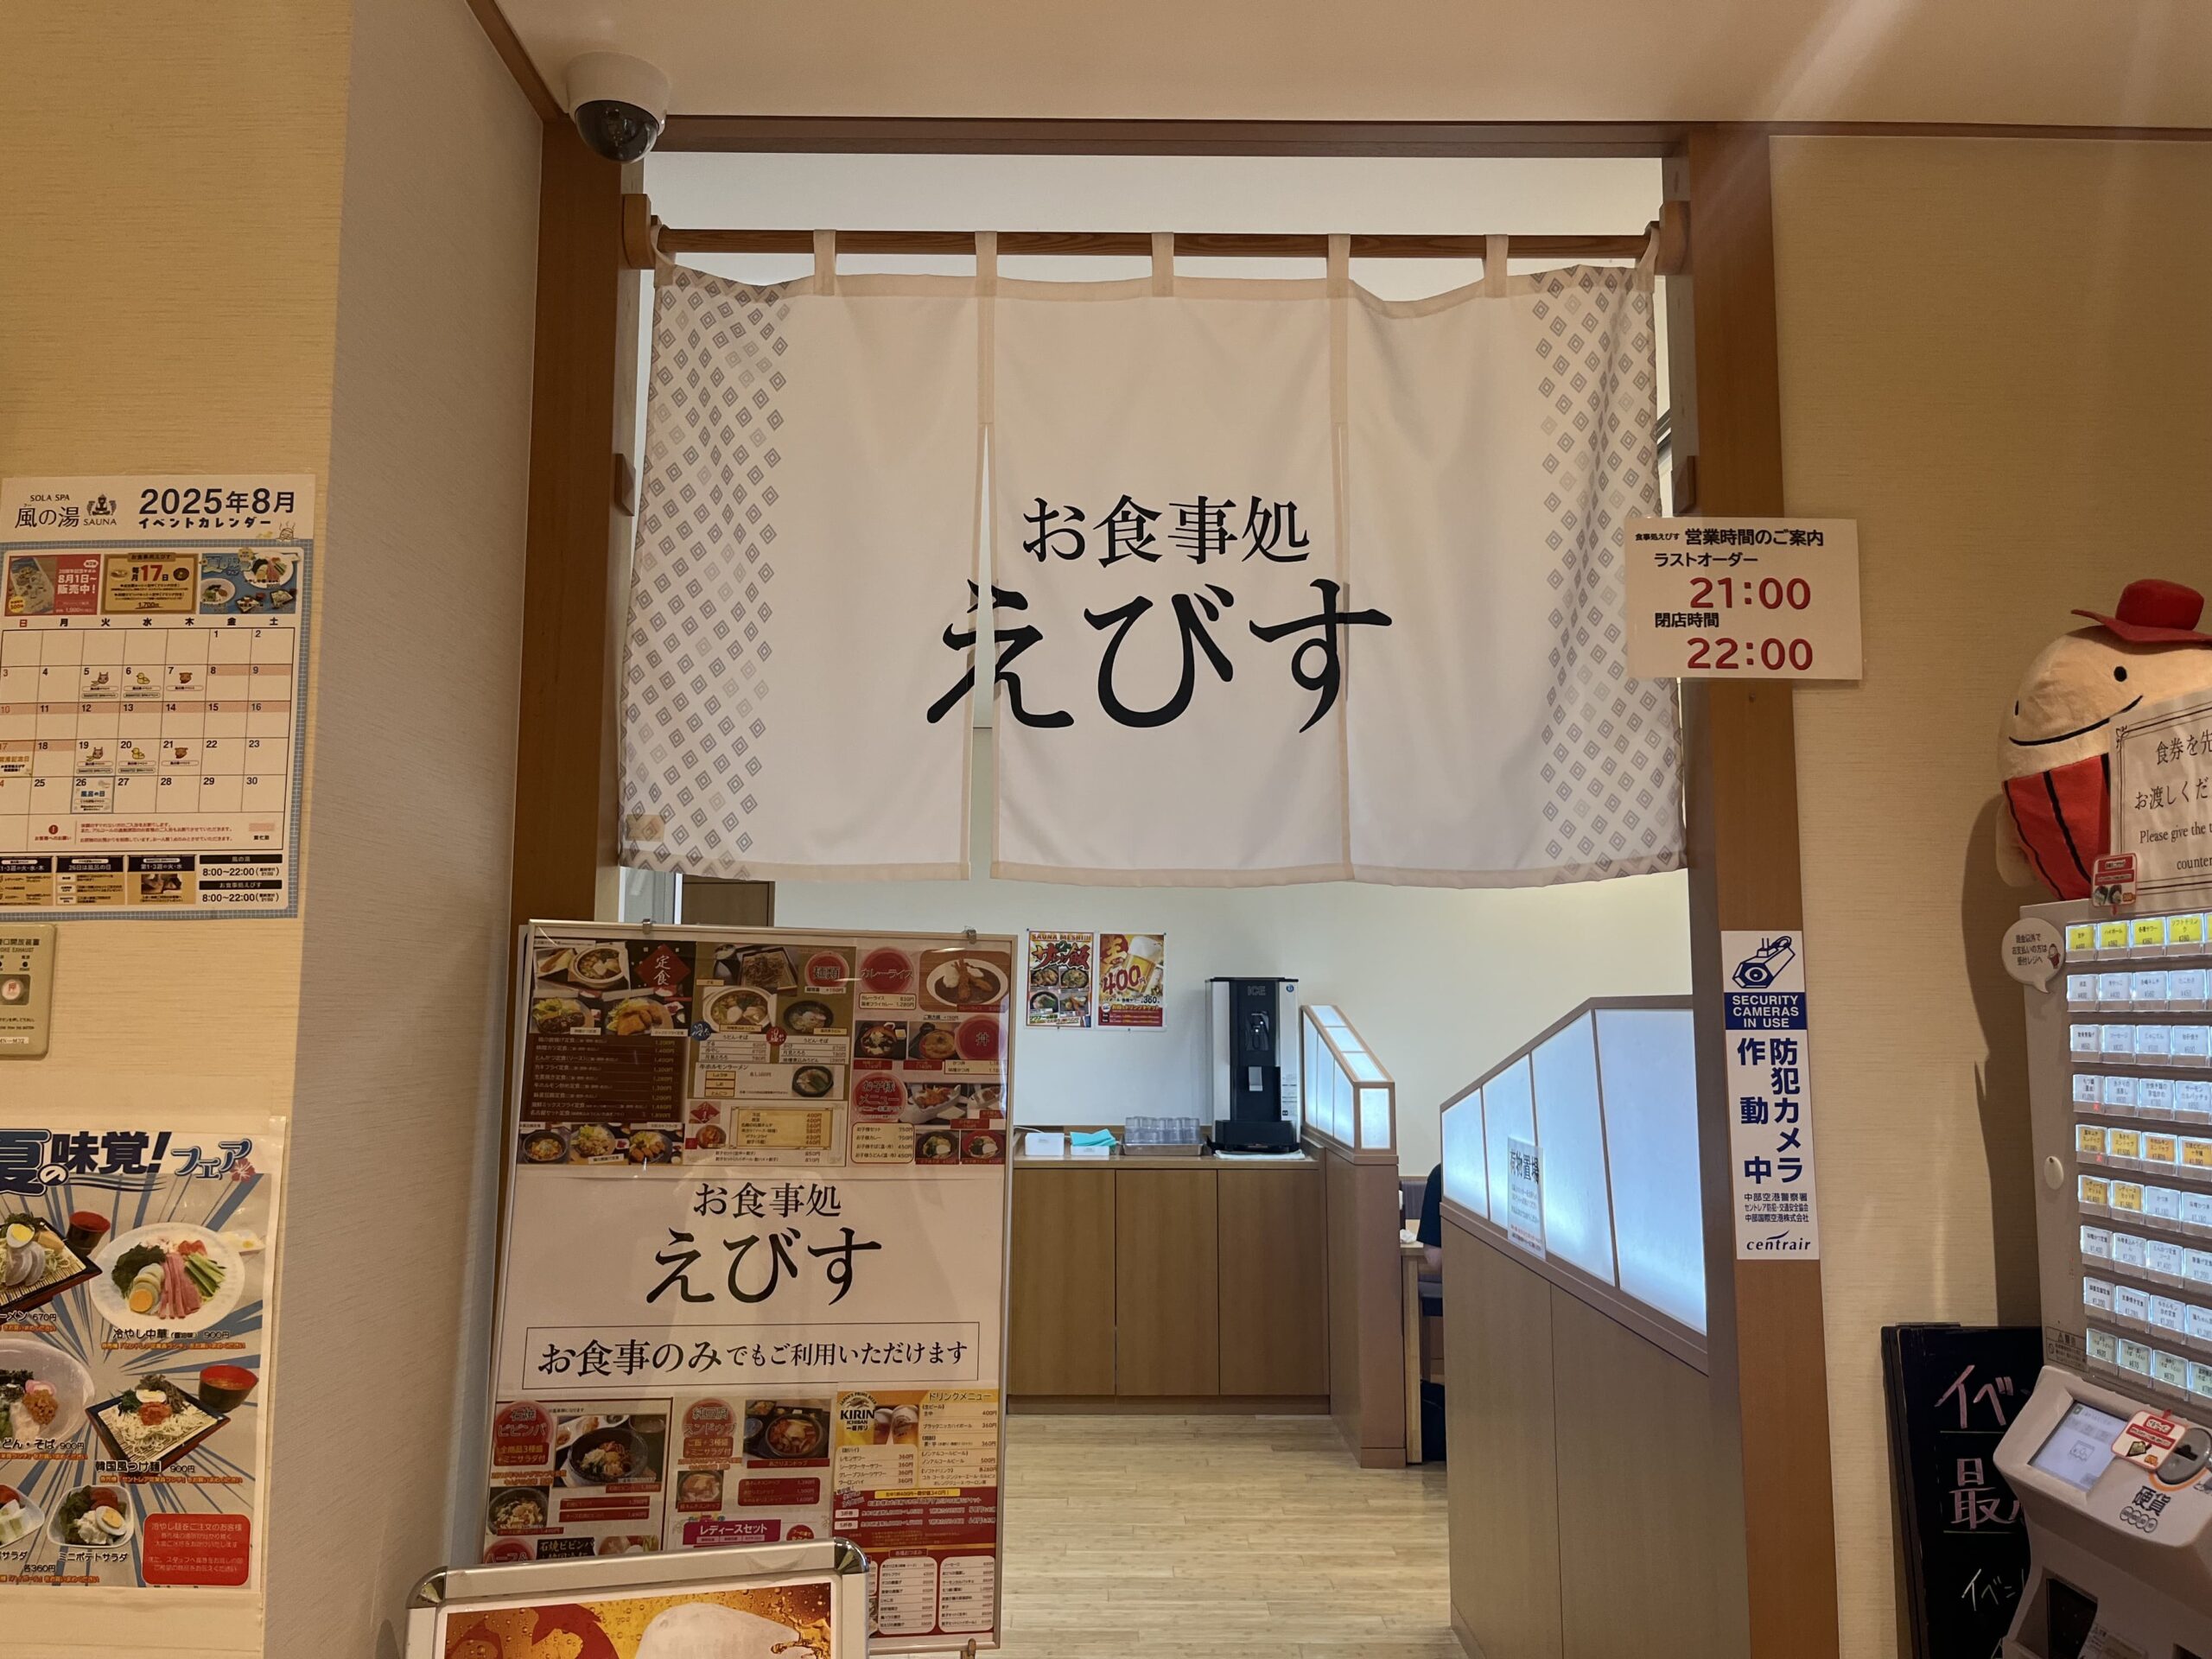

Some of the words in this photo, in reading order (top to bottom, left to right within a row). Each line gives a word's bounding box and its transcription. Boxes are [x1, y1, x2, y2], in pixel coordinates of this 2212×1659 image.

[139, 488, 295, 515] 2025年8月
[15, 505, 80, 529] 風の湯
[138, 518, 272, 529] イベントカレンダー
[1022, 495, 1311, 568] お食事処
[1685, 528, 1824, 546] 営業時間のご案内
[1654, 552, 1758, 567] ラストオーダー
[1689, 577, 1811, 610] 21:00
[19, 619, 28, 627] 日
[60, 618, 68, 626] 月
[101, 618, 111, 626] 火
[143, 617, 152, 626] 水
[185, 617, 194, 626] 木
[226, 617, 236, 626] 金
[270, 617, 278, 626] 土
[1655, 613, 1719, 628] 閉店時間
[926, 578, 1393, 734] えびす
[1687, 637, 1813, 671] 22:00
[3, 669, 9, 677] 3
[40, 704, 49, 713] 11
[81, 703, 92, 712] 12
[123, 703, 134, 712] 13
[165, 703, 176, 712] 14
[208, 702, 219, 711] 15
[251, 702, 261, 711] 16
[120, 741, 132, 749] 20
[162, 741, 174, 749] 21
[206, 740, 218, 748] 22
[249, 740, 260, 748] 23
[2155, 729, 2212, 766] 食券を先
[35, 779, 45, 787] 25
[118, 778, 130, 786] 27
[246, 777, 258, 785] 30
[2134, 777, 2209, 810] お渡しくだ
[2139, 829, 2169, 843] Please
[2171, 824, 2189, 842] give
[2191, 821, 2206, 834] the
[654, 955, 671, 986] 定食
[861, 968, 913, 979] カレーライス
[1103, 964, 1147, 995] 400円
[1732, 995, 1798, 1006] SECURITY
[1733, 1007, 1799, 1016] CAMERAS
[1744, 1018, 1756, 1027] IN
[1763, 1018, 1789, 1027] USE
[859, 1095, 899, 1105] メニュー
[1738, 1038, 1771, 1184] 作動中
[1770, 1038, 1802, 1183] 防犯カメラ
[171, 1138, 252, 1180] フェア
[693, 1182, 842, 1218] お食事処
[1744, 1192, 1808, 1202] 中部空港警察署
[1745, 1213, 1809, 1223] 中部国際空港株式会社
[1746, 1236, 1811, 1250] centrair
[646, 1227, 882, 1306] えびす
[112, 1329, 168, 1339] 冷やし中華
[537, 1338, 968, 1377] お食事のみでもご利用いただけます
[929, 1392, 992, 1402] ドリンクメニュー
[840, 1409, 875, 1420] KIRIN
[3, 1439, 55, 1450] どん・そば
[95, 1461, 161, 1472] 韓国風つけ麺
[1949, 1458, 2020, 1529] 最
[2132, 1485, 2171, 1516] 硬貨
[700, 1522, 768, 1535] レディースセット
[540, 1539, 595, 1552] 石焼ビビンバ
[0, 1551, 28, 1560] サラダ
[60, 1553, 128, 1562] ミニポテトサラダ
